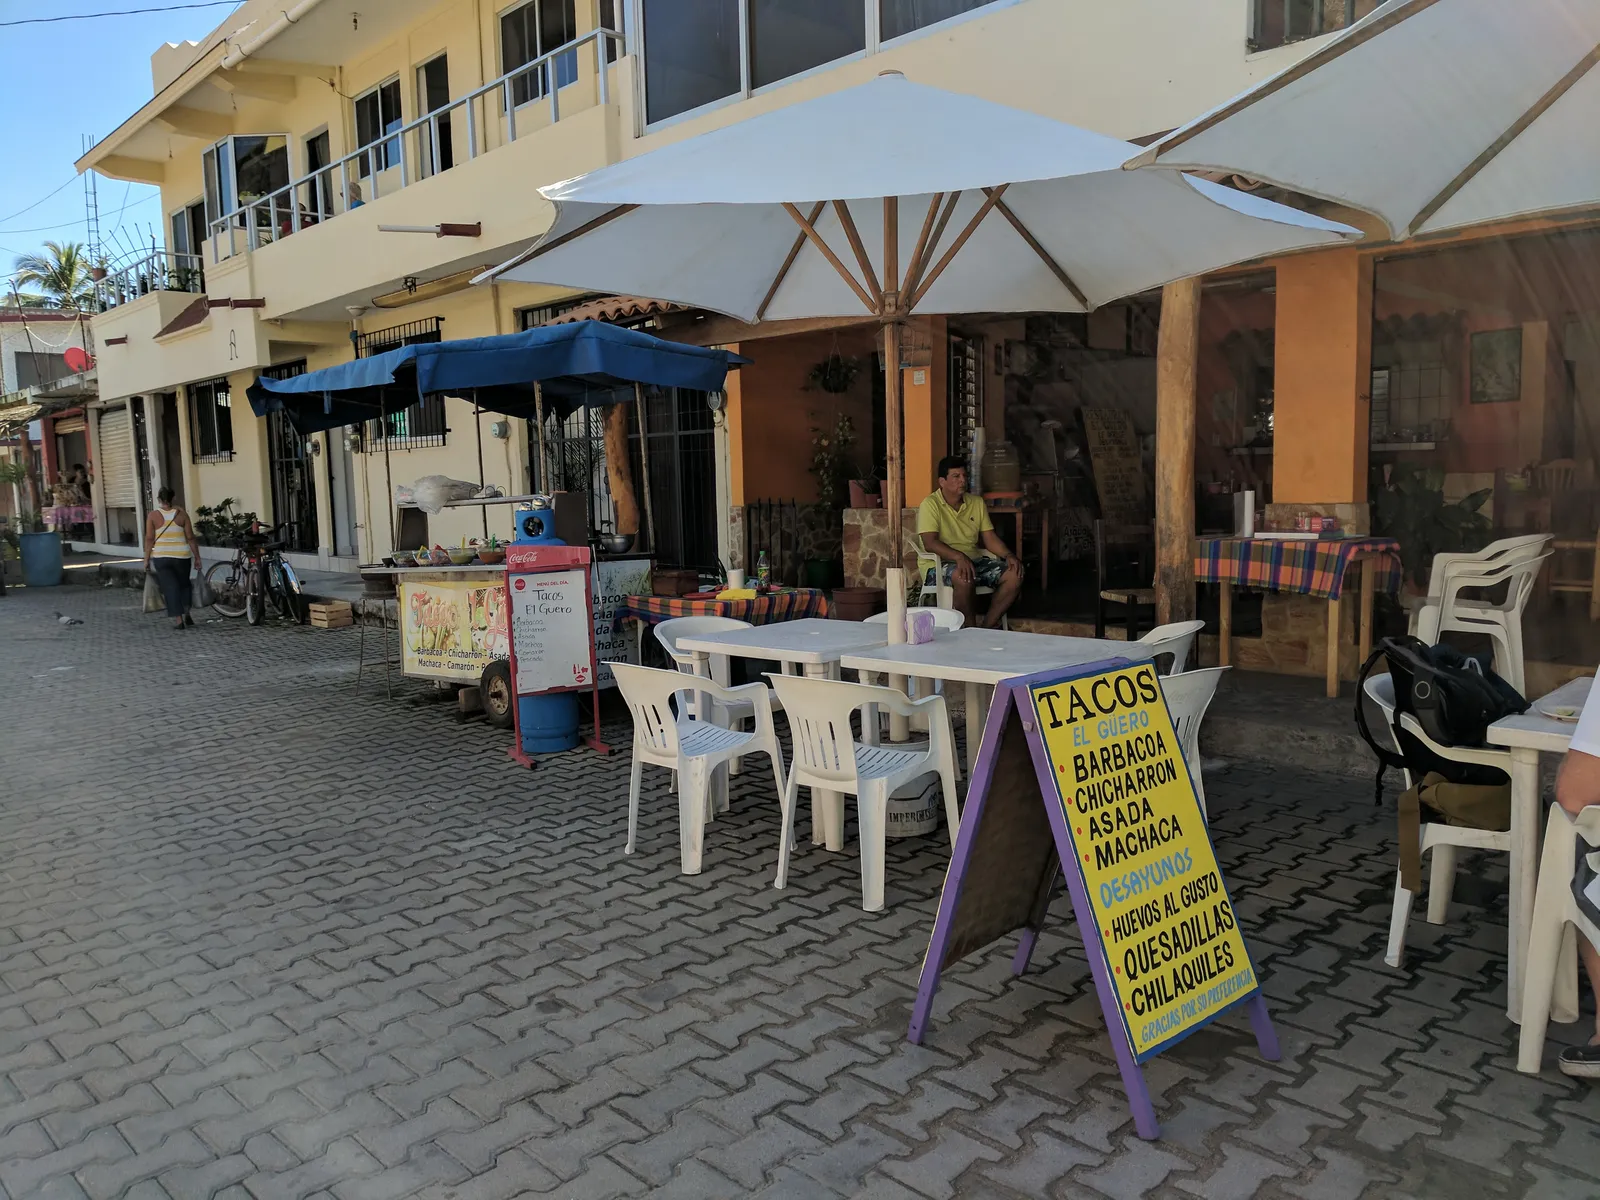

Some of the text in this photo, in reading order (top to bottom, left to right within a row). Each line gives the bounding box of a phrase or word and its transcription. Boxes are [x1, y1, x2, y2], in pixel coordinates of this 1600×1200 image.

[525, 604, 536, 615] El
[532, 589, 564, 601] Tacos
[592, 593, 628, 605] bacoa
[417, 647, 443, 656] Barbacoa
[488, 651, 510, 661] Asada
[418, 659, 442, 669] Machaca
[447, 661, 475, 671] Camarón
[1038, 668, 1158, 729] TACOS
[1073, 709, 1149, 747] EL GÜERO
[1073, 730, 1167, 783] BARBACOA
[1075, 757, 1178, 814] CHICHARRON
[1089, 797, 1154, 841] ASADA
[1094, 814, 1183, 870] MACHACA
[1100, 847, 1193, 909] DESAYUNOS
[1111, 871, 1219, 944] HUEVOS AL GUSTO
[1123, 899, 1235, 983] QUESADILLAS
[1131, 940, 1235, 1017] CHILAQUILES
[1141, 968, 1254, 1043] GRACIAS POR SU PREFERENCIA
